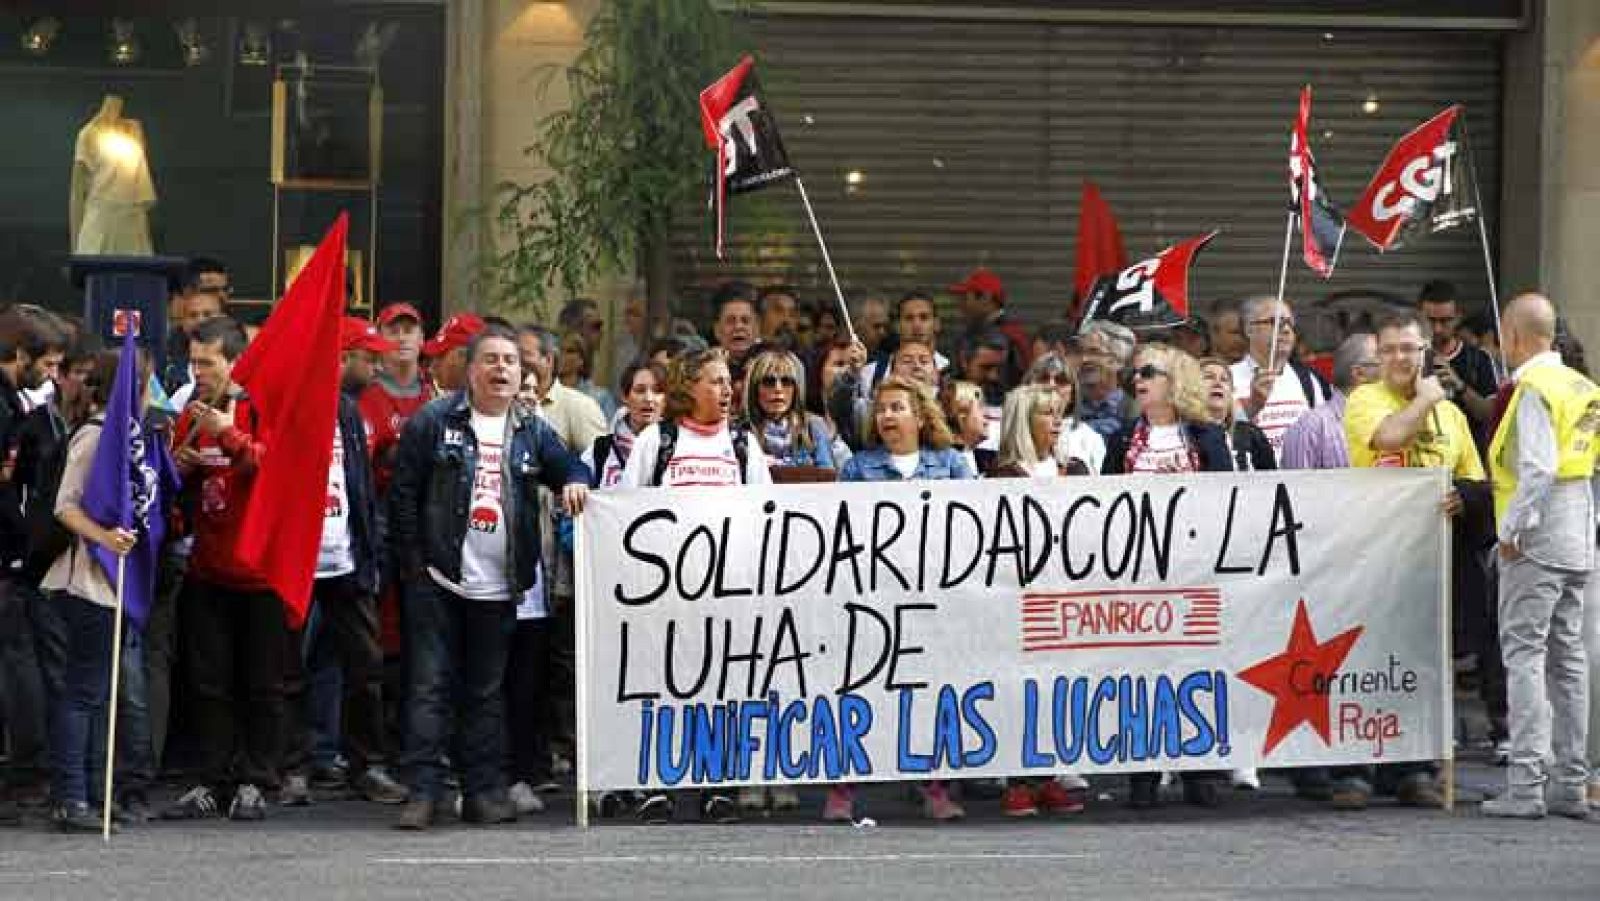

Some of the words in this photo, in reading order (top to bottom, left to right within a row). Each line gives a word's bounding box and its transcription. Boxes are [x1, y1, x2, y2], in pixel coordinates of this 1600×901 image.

[1371, 141, 1458, 222] CGT
[1214, 483, 1304, 576] LA
[835, 601, 938, 696] DE
[1058, 599, 1175, 637] PANRICO
[1288, 654, 1418, 696] Corriente
[896, 682, 999, 773] LAS
[1021, 671, 1232, 769] LUCHAS!
[1338, 701, 1402, 757] Roja
